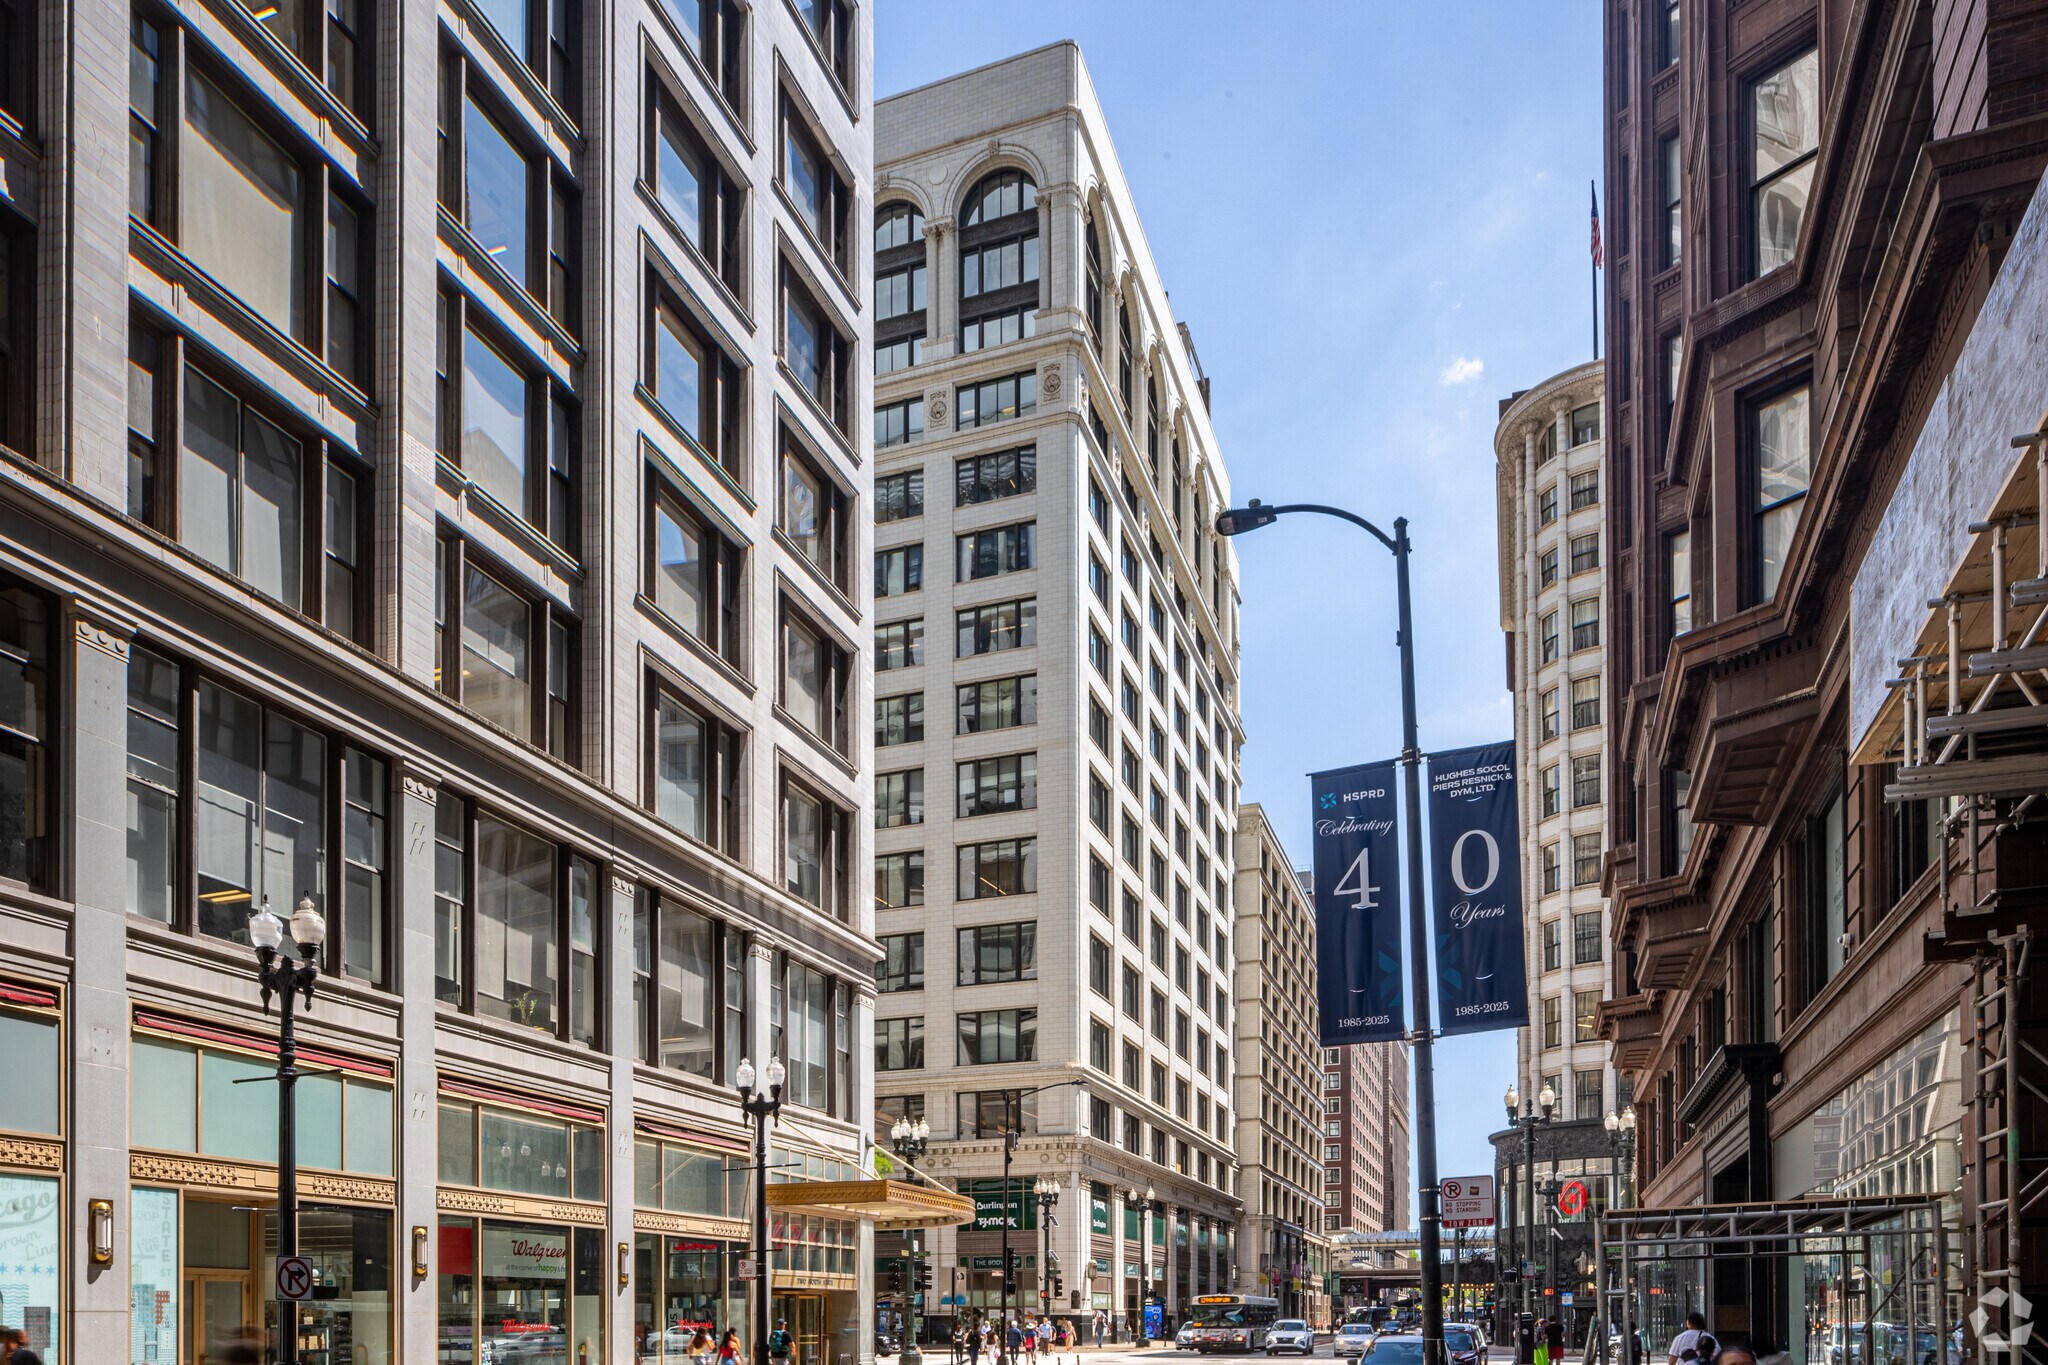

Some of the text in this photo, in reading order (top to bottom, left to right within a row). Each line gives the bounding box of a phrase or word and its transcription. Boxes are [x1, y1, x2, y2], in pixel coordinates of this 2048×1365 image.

[1435, 763, 1510, 782] HUGHES SOCOL
[1432, 772, 1513, 792] PIERS RESNICK &
[1450, 783, 1496, 798] DYM, LTD.
[1343, 788, 1385, 803] HSPRD
[1315, 818, 1394, 837] Celebrating
[1450, 829, 1500, 895] 0
[1333, 847, 1381, 909] 4
[1450, 901, 1505, 929] Years
[1454, 1001, 1510, 1017] 1985-2025
[1338, 1015, 1390, 1028] 1985-2025
[1467, 1218, 1488, 1226] ZONE
[538, 1263, 557, 1274] happy
